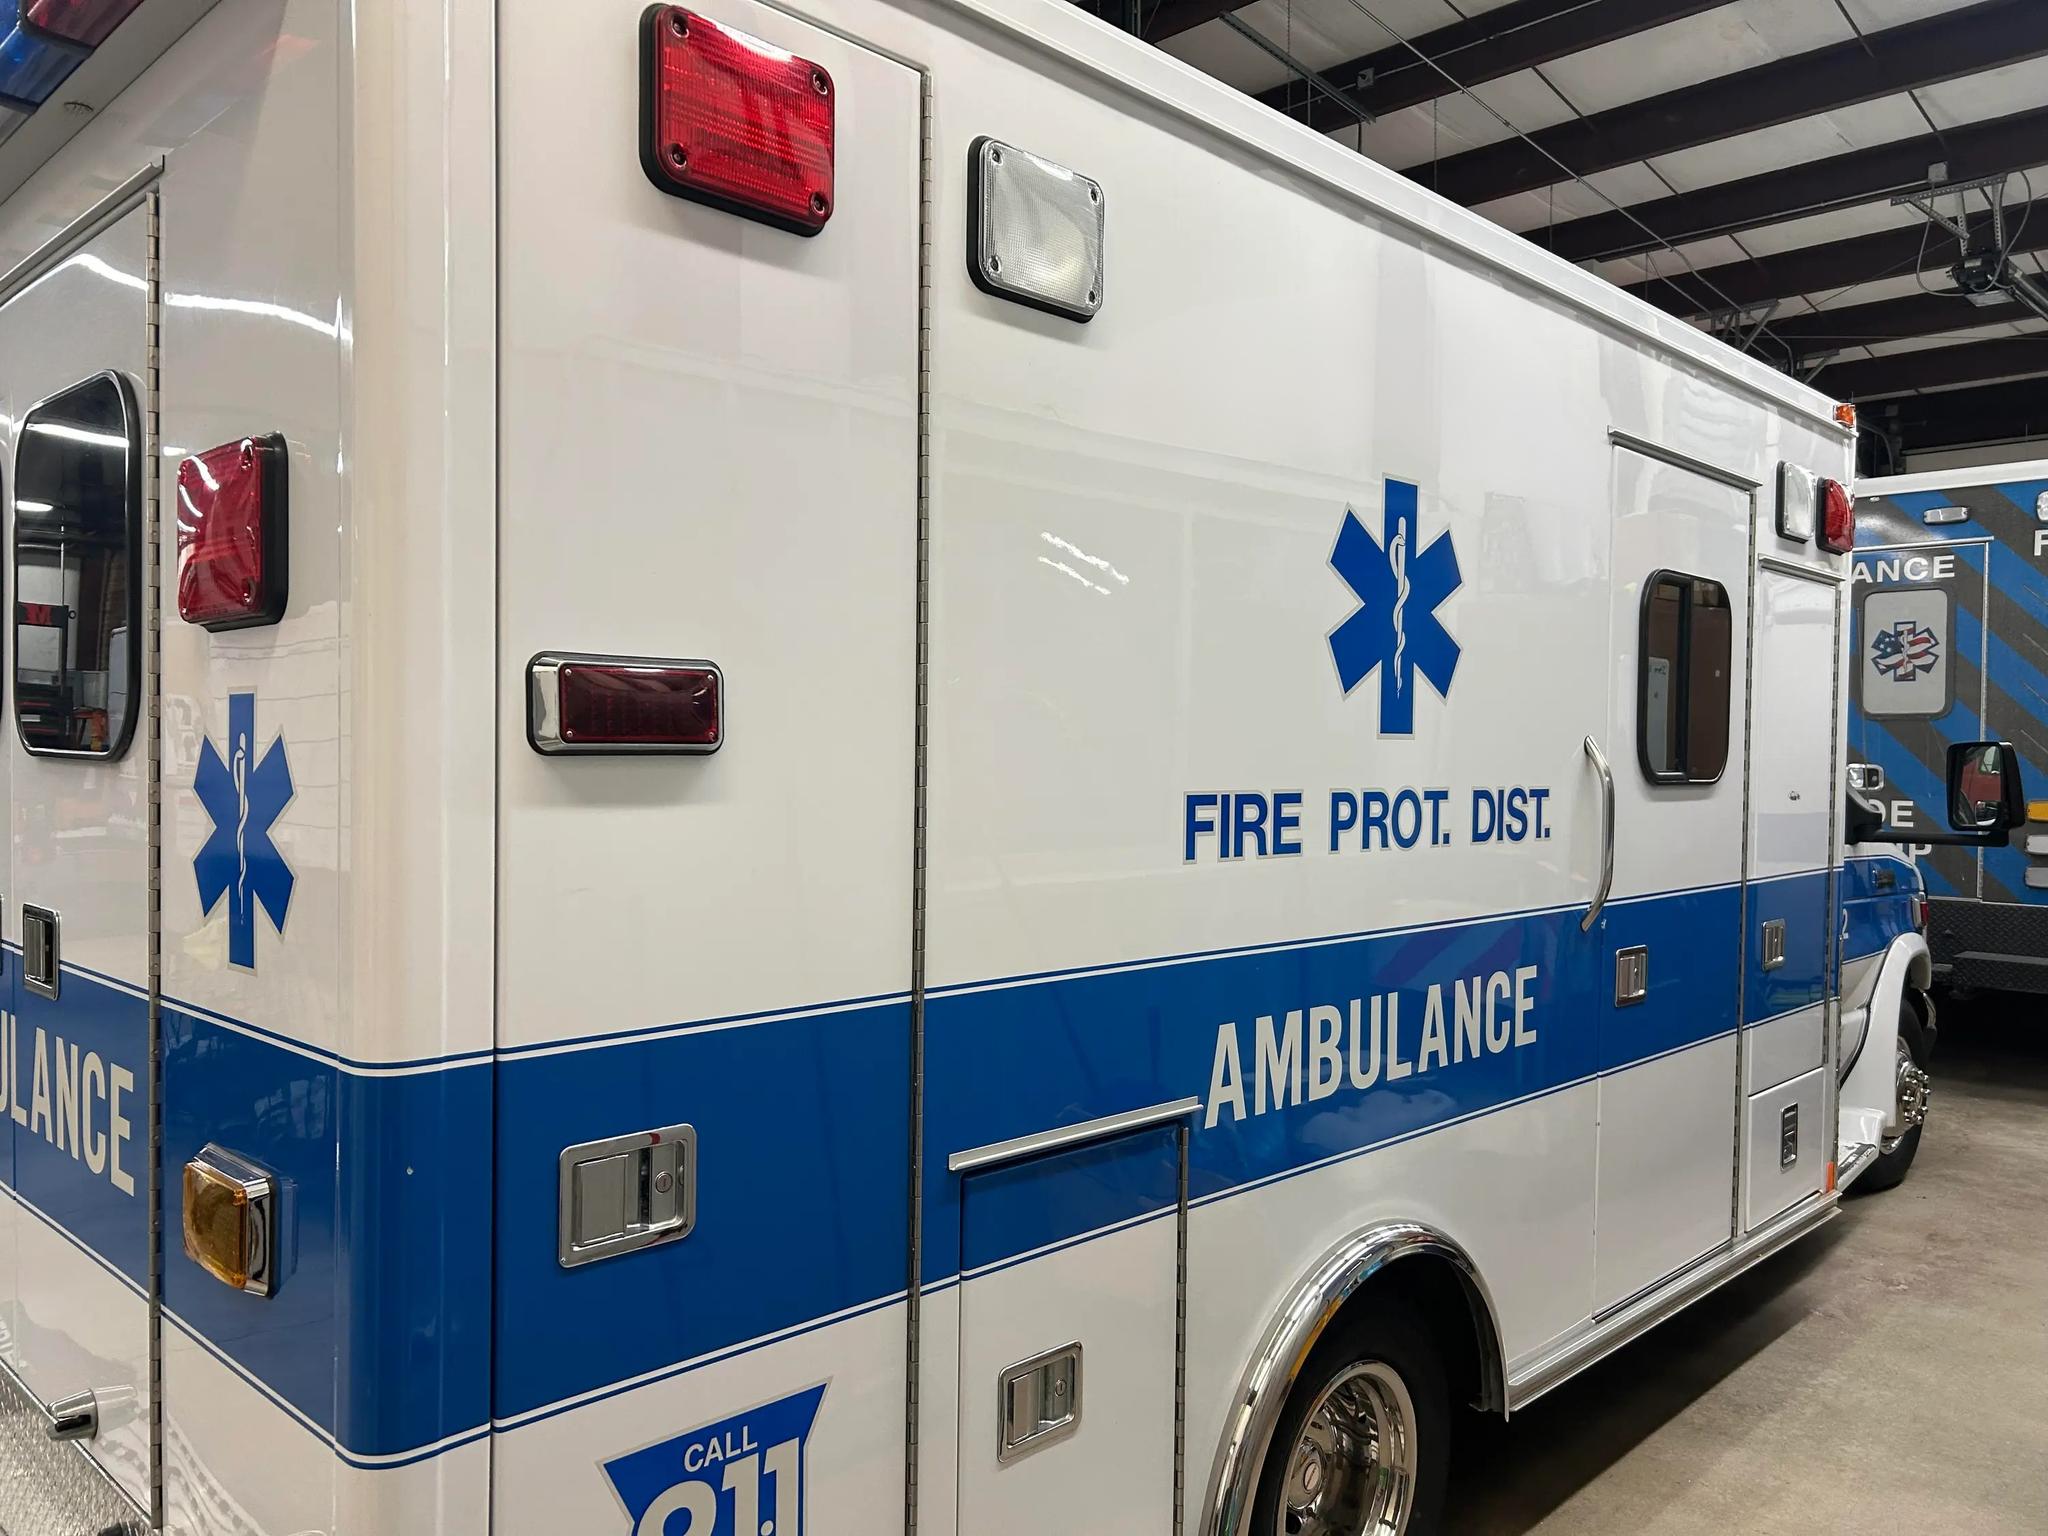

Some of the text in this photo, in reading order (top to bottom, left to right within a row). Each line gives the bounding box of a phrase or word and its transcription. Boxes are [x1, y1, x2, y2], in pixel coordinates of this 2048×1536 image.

[1184, 786, 1551, 863] FIRE PROT. DIST.
[1204, 965, 1537, 1129] AMBULANCE
[683, 1425, 758, 1472] CALL
